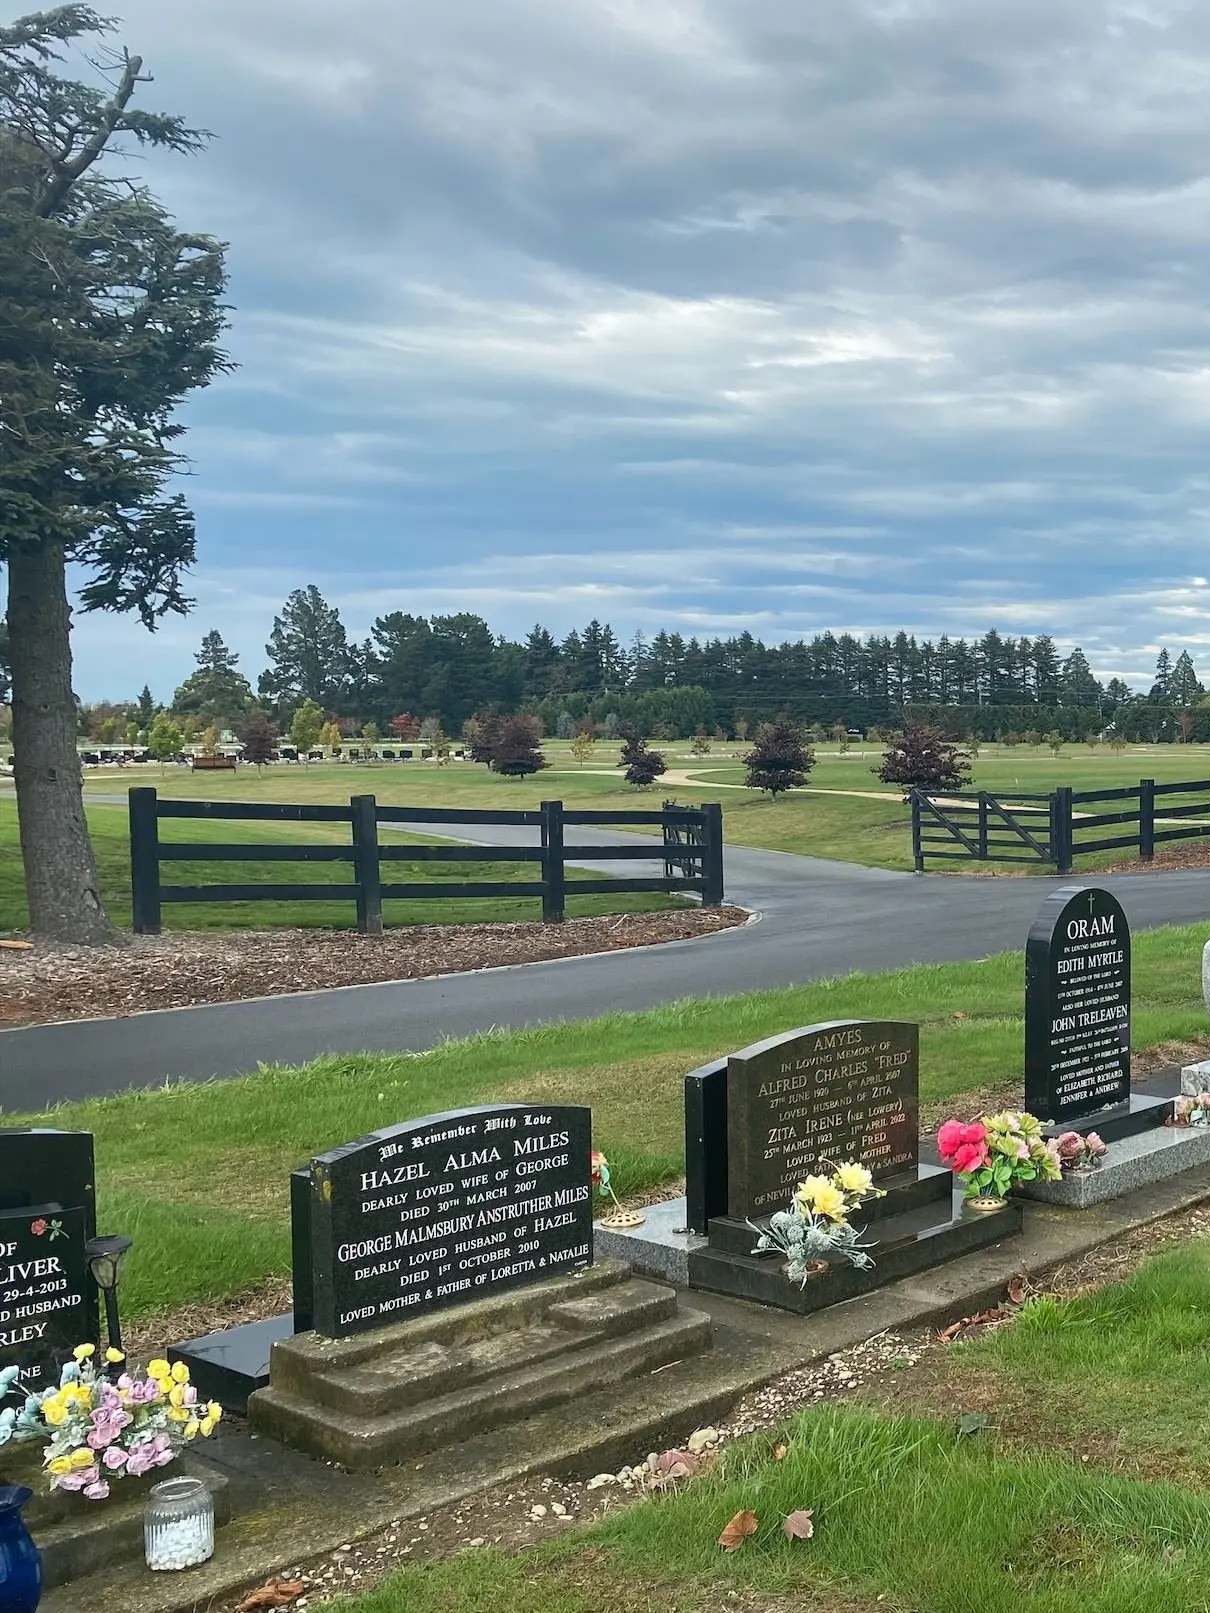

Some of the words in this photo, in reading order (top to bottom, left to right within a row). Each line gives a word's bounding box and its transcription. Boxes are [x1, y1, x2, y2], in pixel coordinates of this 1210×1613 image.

[1067, 915, 1115, 940] ORAM
[1057, 957, 1084, 974] EDITH
[1088, 951, 1123, 968] MYRTLE
[1071, 943, 1089, 952] LOVING
[1090, 940, 1110, 949] MEMORY
[1051, 1015, 1075, 1033] JOHN
[1078, 1004, 1128, 1027] TRELEAVEN
[1062, 1002, 1073, 1011] ALSO
[1085, 997, 1099, 1006] LOVED
[1100, 994, 1119, 1003] HUSBAND
[781, 1063, 791, 1072] IN
[796, 1054, 832, 1069] LOVING
[840, 1045, 874, 1061] MEMORY
[880, 1041, 891, 1051] OF
[814, 1029, 862, 1052] AMYES
[758, 1075, 807, 1097] ALFRED
[815, 1060, 868, 1082] CHARLES
[788, 1092, 810, 1104] JUNE
[861, 1074, 883, 1086] APRIL
[1060, 1072, 1075, 1082] LOVED
[1076, 1068, 1094, 1077] MOTHER
[779, 1107, 807, 1122] LOVED
[813, 1097, 852, 1113] HUSBAND
[857, 1092, 867, 1102] OF
[872, 1086, 892, 1099] ZITA
[1060, 1091, 1088, 1105] JENNIFER
[1095, 1081, 1120, 1095] ANDREW
[378, 1143, 404, 1162] We
[411, 1123, 477, 1149] Remember
[484, 1117, 516, 1134] With
[524, 1114, 552, 1126] Love
[768, 1126, 797, 1144] ZITA
[806, 1113, 843, 1134] IRENE
[783, 1138, 813, 1154] MARCH
[817, 1133, 832, 1144] 1923
[866, 1119, 888, 1131] APRIL
[360, 1162, 430, 1191] HAZEL
[444, 1146, 501, 1173] ALMA
[513, 1131, 570, 1156] MILES
[780, 1168, 809, 1184] LOVED
[859, 1145, 892, 1160] MOTHER
[786, 1153, 815, 1168] LOVED
[821, 1145, 841, 1157] WIFE
[846, 1141, 857, 1151] OF
[862, 1132, 886, 1147] FRED
[361, 1192, 408, 1213] DEARLY
[416, 1183, 454, 1200] LOVED
[461, 1174, 489, 1189] WIFE
[495, 1169, 509, 1181] OF
[516, 1154, 569, 1176] GEORGE
[754, 1195, 765, 1205] OF
[883, 1152, 913, 1168] SANDRA
[401, 1203, 430, 1222] DIED
[466, 1186, 507, 1205] MARCH
[514, 1180, 537, 1193] 2007
[338, 1235, 392, 1262] GEORGE
[395, 1214, 475, 1246] MALMSBURY
[477, 1195, 552, 1228] ANSTRUTHER
[554, 1185, 589, 1207] MILES
[355, 1258, 402, 1280] DEARLY
[409, 1247, 448, 1266] LOVED
[455, 1232, 506, 1254] HUSBAND
[514, 1226, 527, 1238] OF
[534, 1211, 577, 1233] HAZEL
[400, 1270, 429, 1286] DIED
[459, 1247, 511, 1269] OCTOBER
[518, 1240, 540, 1254] 2010
[3, 1279, 68, 1302] 29-4-2013
[340, 1306, 375, 1324] LOVED
[379, 1293, 421, 1313] MOTHER
[424, 1289, 433, 1299] &
[436, 1279, 472, 1296] FATHER
[475, 1273, 487, 1285] OF
[491, 1260, 536, 1281] LORETTA
[539, 1257, 546, 1267] &
[549, 1244, 589, 1264] NATALIE
[15, 1294, 82, 1319] HUSBAND
